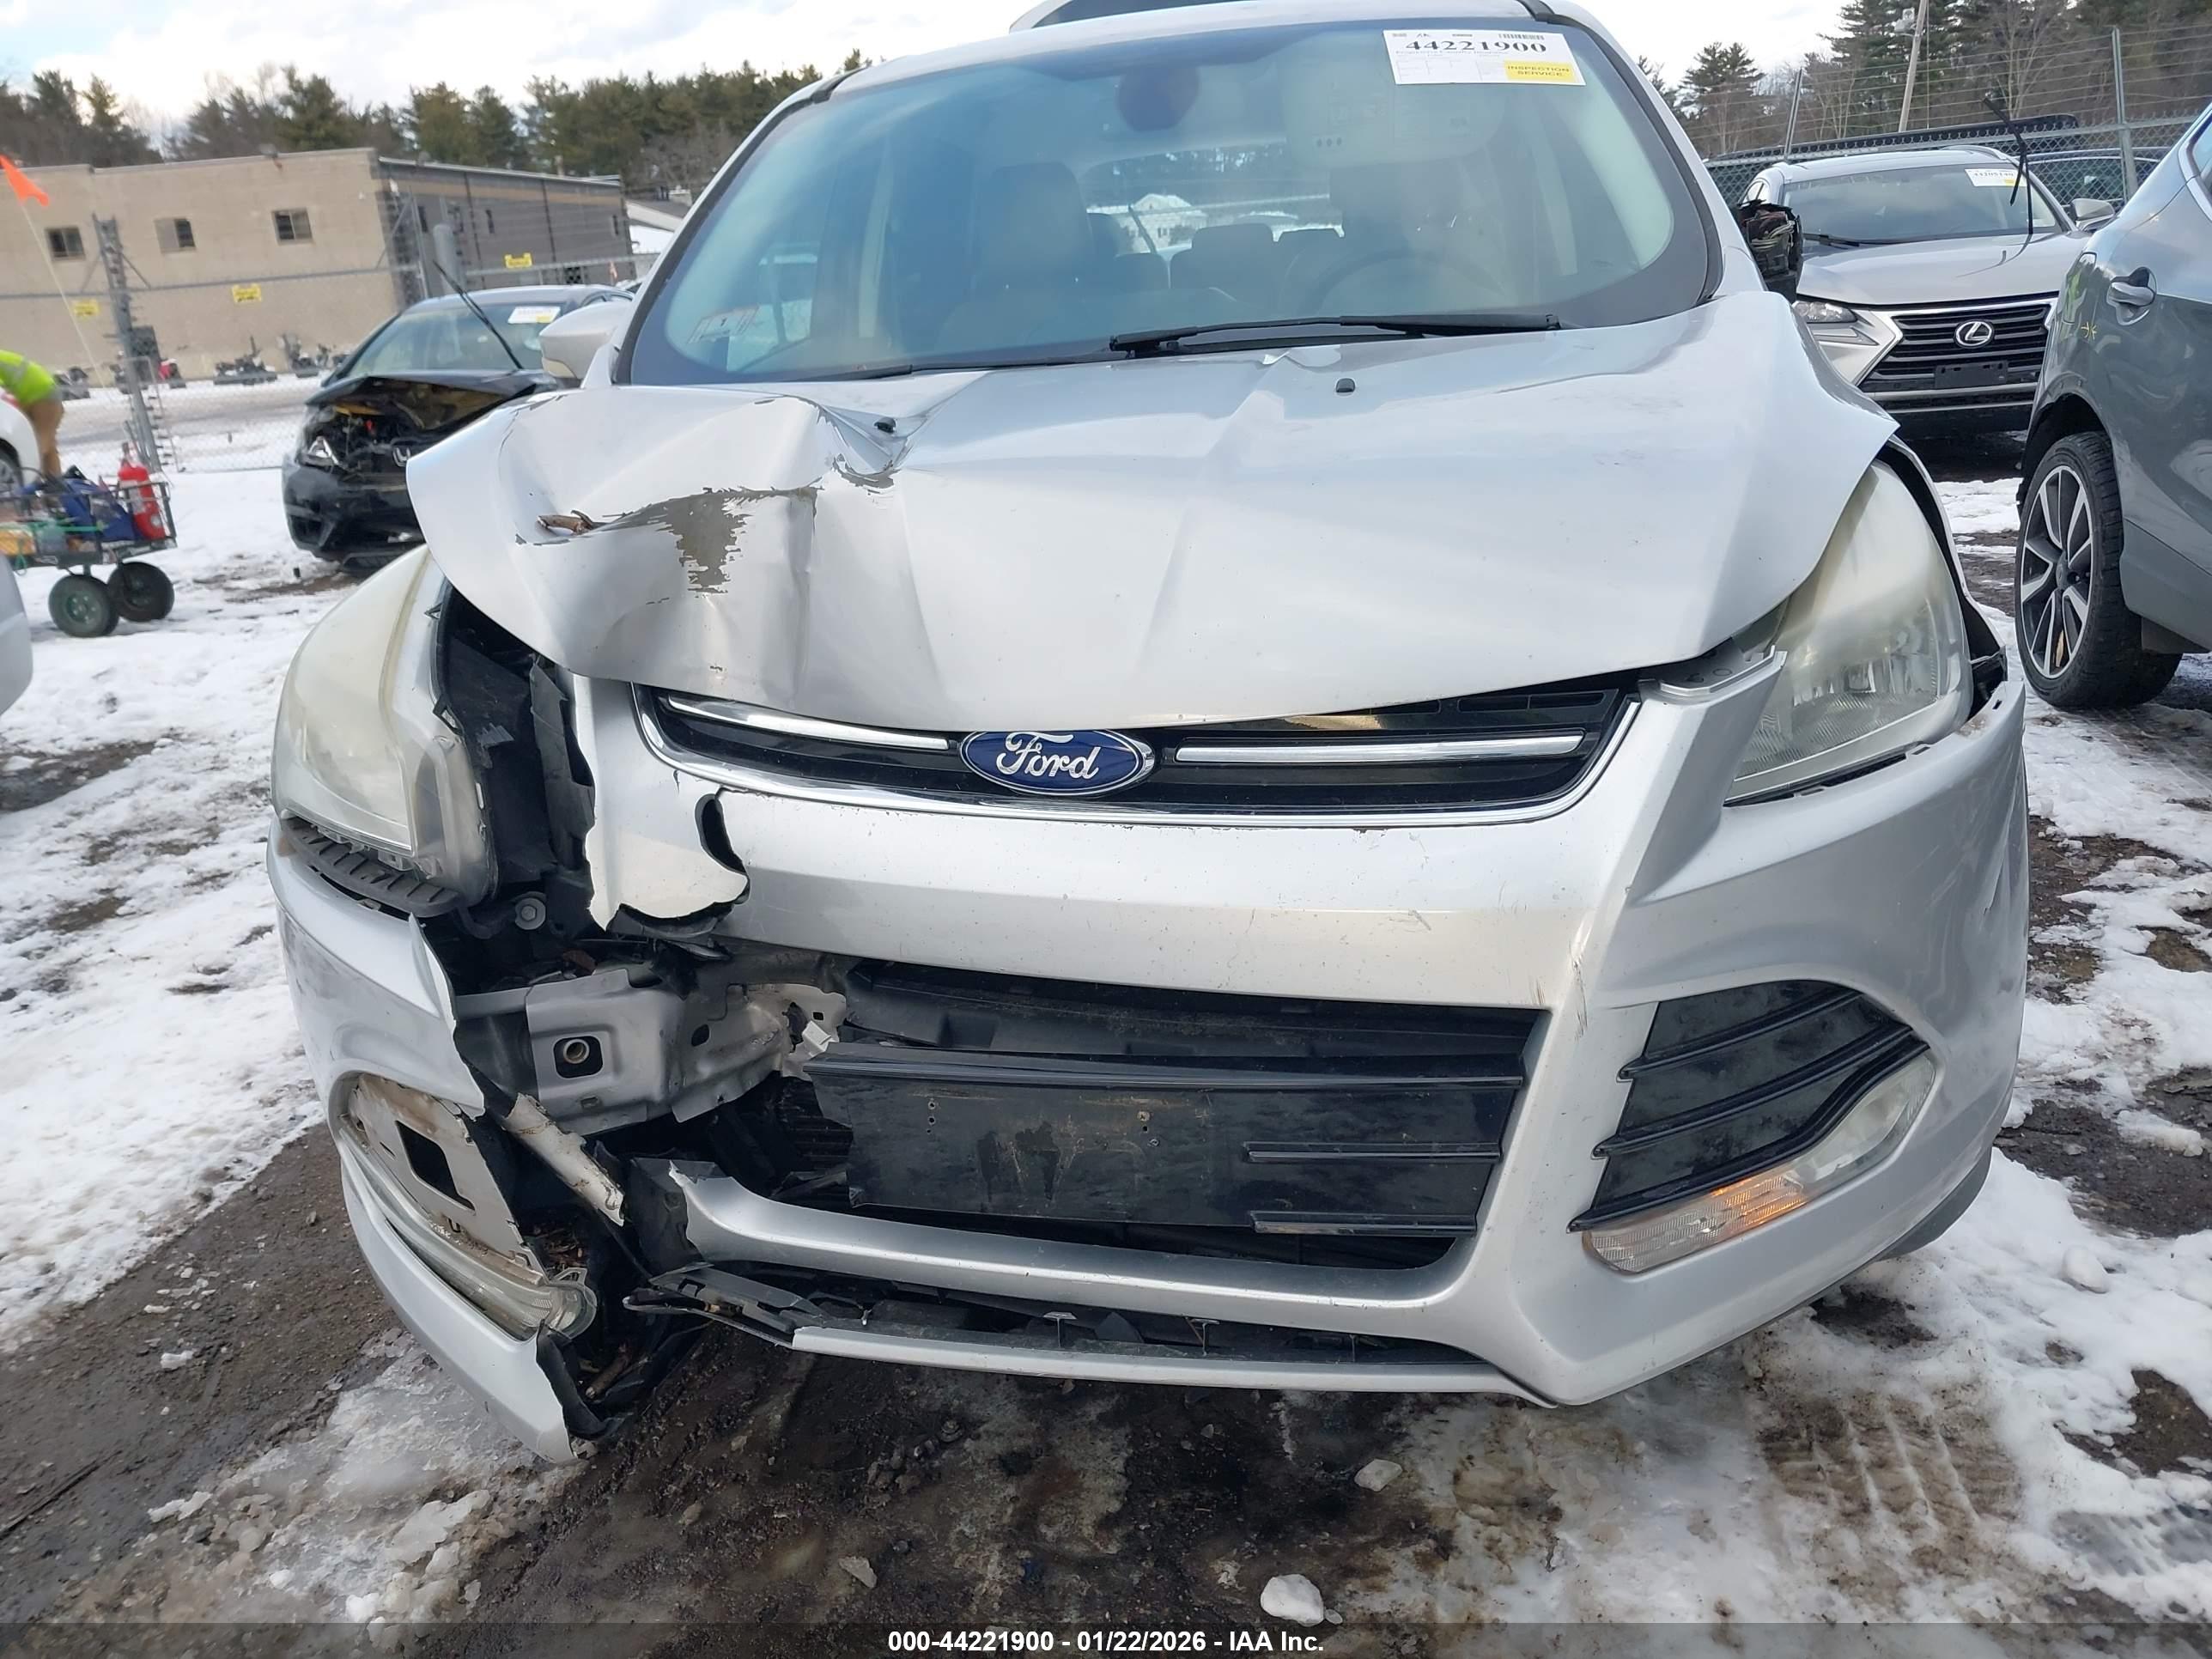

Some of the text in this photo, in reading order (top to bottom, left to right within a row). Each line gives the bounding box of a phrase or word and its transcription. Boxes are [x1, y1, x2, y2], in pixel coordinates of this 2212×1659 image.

[1406, 40, 1547, 52] 44221900
[1507, 64, 1570, 73] INSPECTION
[996, 732, 1101, 780] Ford
